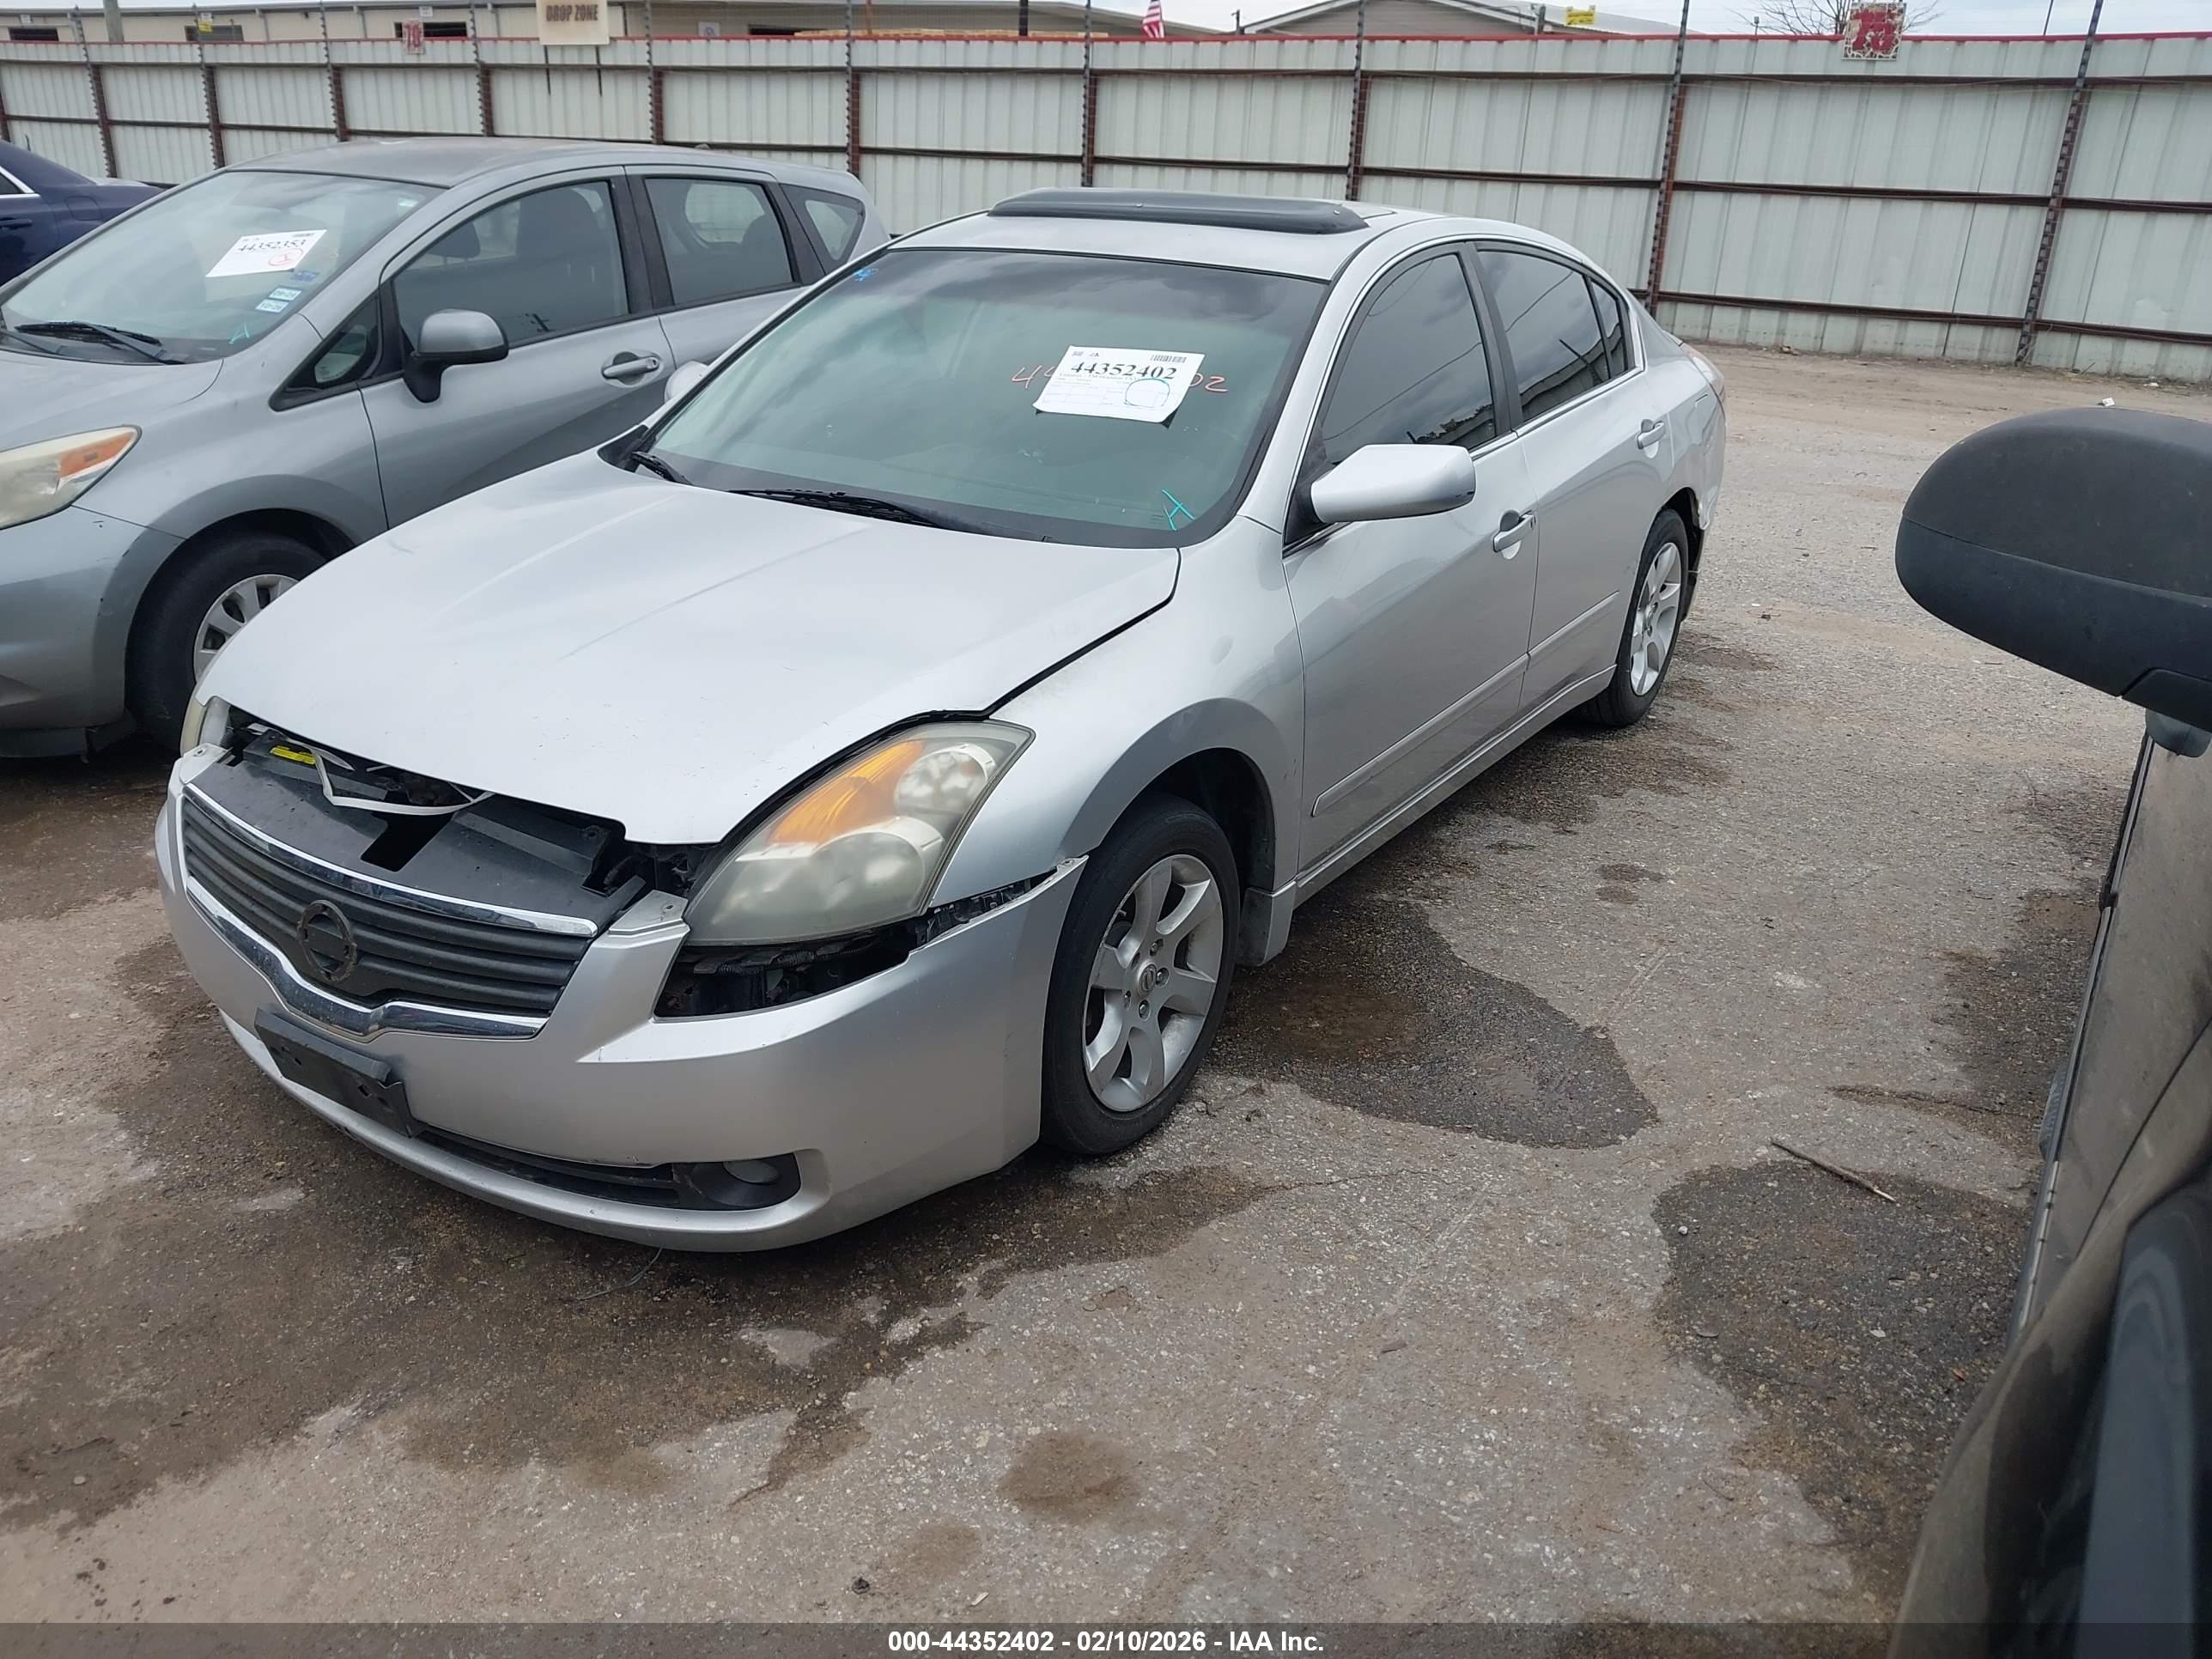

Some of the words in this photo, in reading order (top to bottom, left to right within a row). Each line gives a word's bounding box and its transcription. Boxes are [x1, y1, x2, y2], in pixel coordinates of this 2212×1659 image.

[546, 4, 573, 21] DROP
[574, 3, 599, 21] ZONE
[1071, 361, 1177, 380] 44352402
